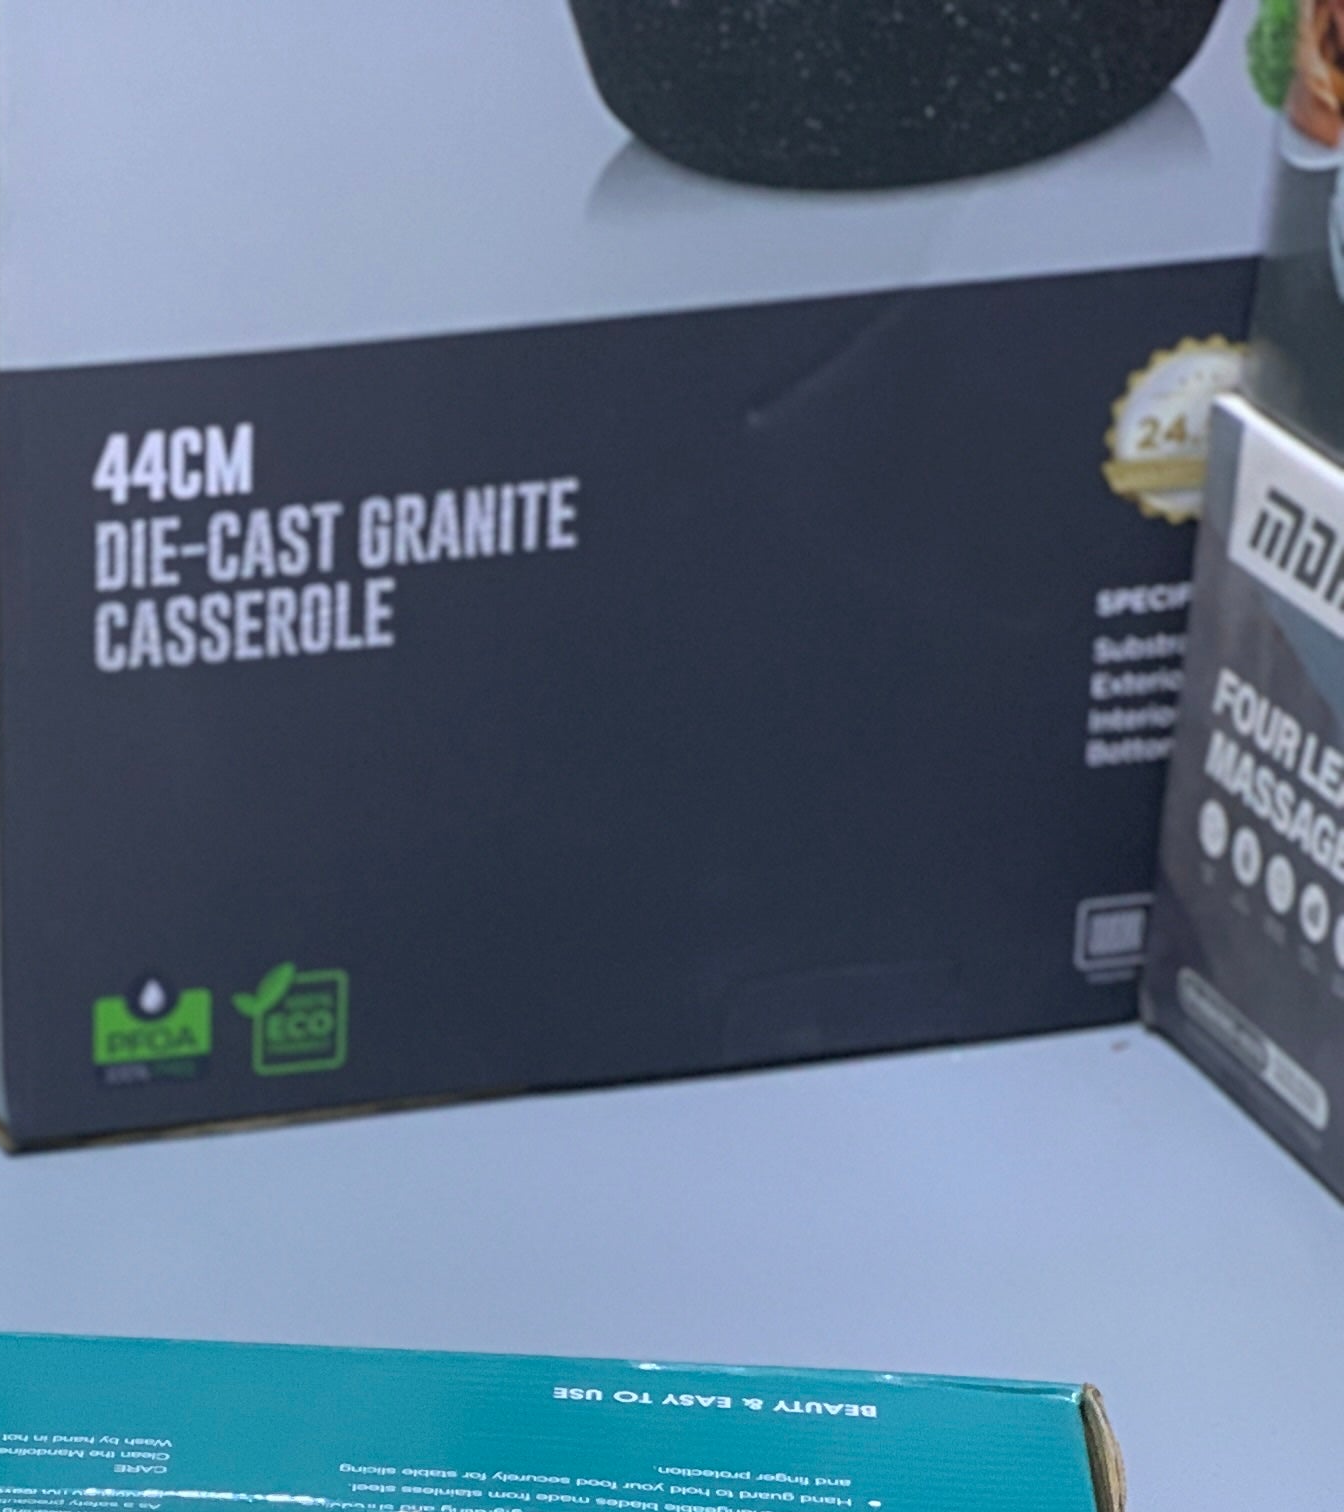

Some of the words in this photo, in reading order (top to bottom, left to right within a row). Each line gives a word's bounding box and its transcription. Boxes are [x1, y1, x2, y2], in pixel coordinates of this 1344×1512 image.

[93, 423, 254, 504] 44CM
[95, 502, 343, 592] DIE-CAST
[358, 477, 579, 569] GRANITE
[94, 577, 395, 673] CASSEROLE
[1212, 667, 1301, 772] FOUR
[266, 1009, 335, 1042] ECO
[552, 1387, 602, 1400] USE
[613, 1390, 651, 1403] TO
[661, 1393, 731, 1407] EASY
[741, 1397, 763, 1409] &
[773, 1400, 877, 1416] BEAUTY
[2, 1433, 28, 1441] hot
[33, 1434, 47, 1442] in
[53, 1434, 94, 1443] hand
[100, 1435, 118, 1444] by
[124, 1437, 172, 1447] Wash
[89, 1449, 114, 1458] the
[120, 1451, 169, 1460] Clean
[113, 1464, 166, 1473] CARE
[339, 1463, 395, 1474] slicing
[402, 1468, 456, 1478] stable
[461, 1471, 486, 1481] for
[492, 1472, 570, 1484] securely
[755, 1471, 808, 1485] finger
[576, 1478, 616, 1489] food
[622, 1481, 664, 1491] your
[814, 1477, 850, 1487] and
[401, 1486, 482, 1496] stainless
[488, 1490, 530, 1500] from
[670, 1486, 709, 1495] hold
[715, 1489, 733, 1497] to
[739, 1490, 794, 1501] guard
[535, 1493, 589, 1504] made
[800, 1495, 851, 1505] Hand
[595, 1498, 658, 1510] blades
